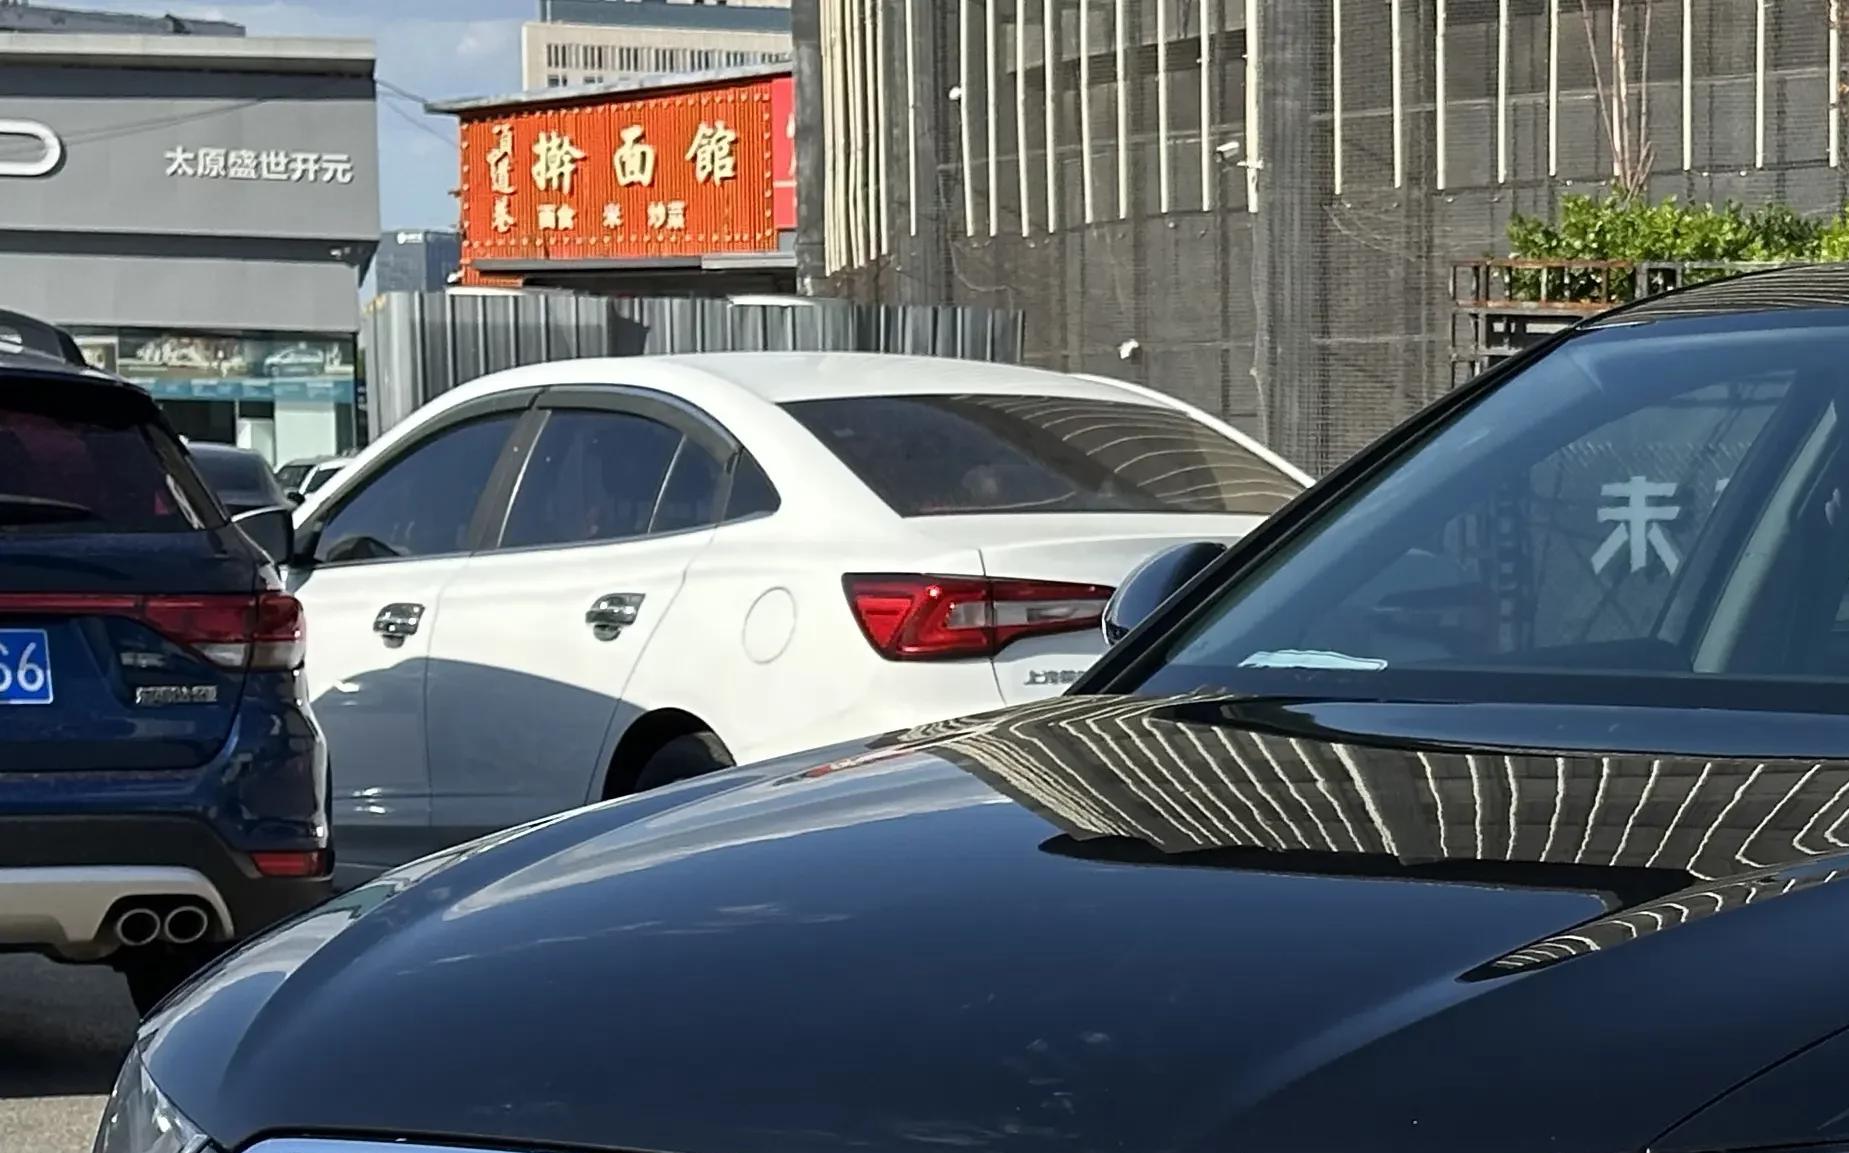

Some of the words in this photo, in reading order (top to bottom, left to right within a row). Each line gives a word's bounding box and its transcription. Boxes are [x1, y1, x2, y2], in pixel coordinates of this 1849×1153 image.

[164, 145, 355, 184] 太原盛世开元
